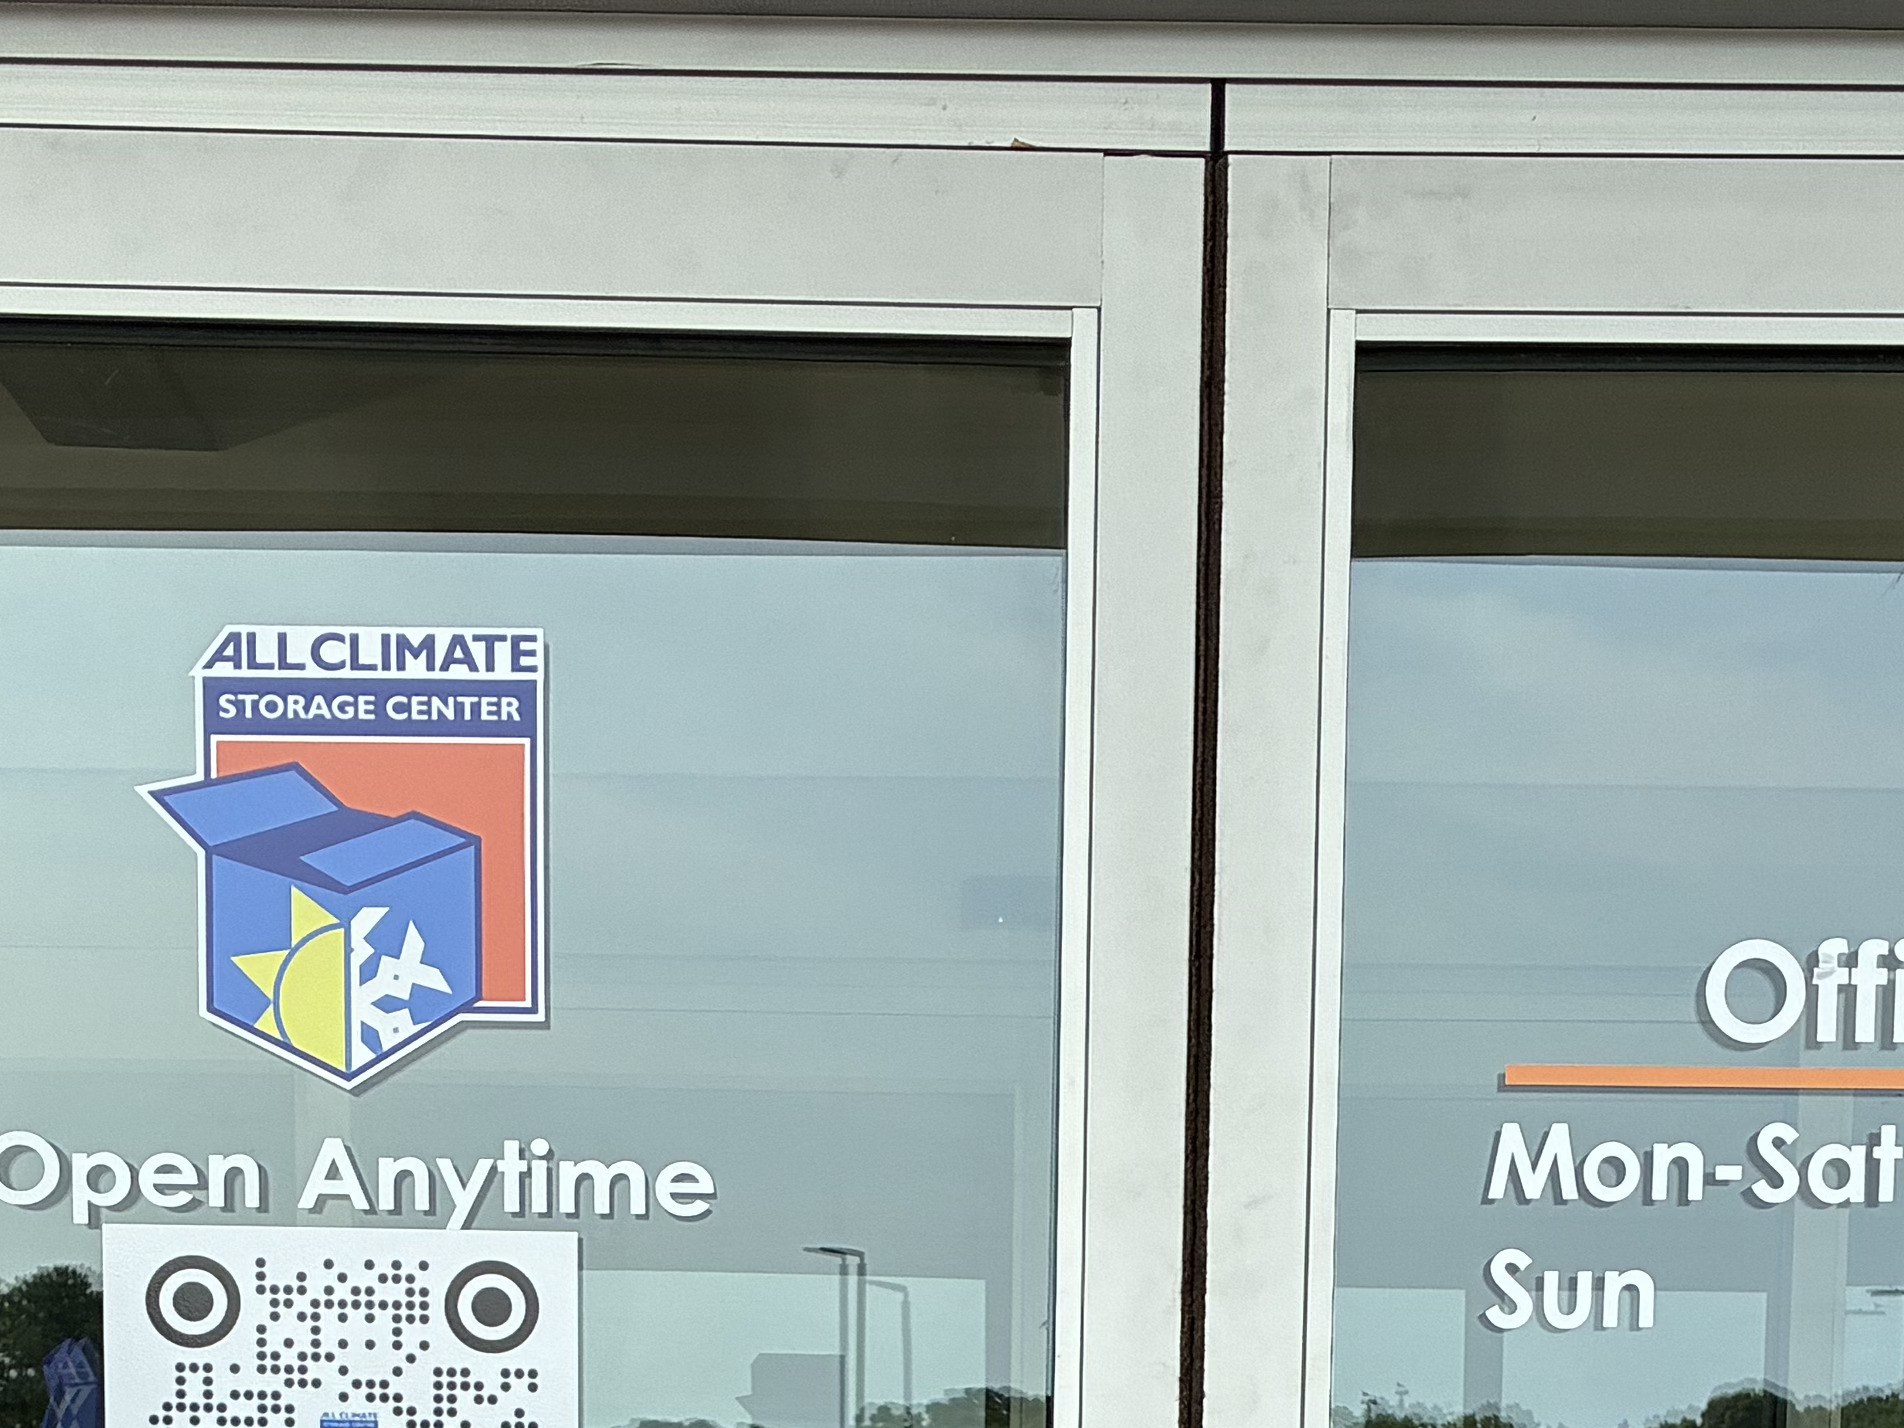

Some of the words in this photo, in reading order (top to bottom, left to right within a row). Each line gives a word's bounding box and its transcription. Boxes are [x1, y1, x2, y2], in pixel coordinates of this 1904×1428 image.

[204, 628, 311, 675] ALL
[308, 628, 540, 675] CLIMATE
[218, 693, 376, 720] STORAGE
[385, 695, 521, 722] CENTER
[299, 1137, 715, 1228] Anytime
[1487, 1122, 1904, 1204] Mon-Sat
[1485, 1248, 1655, 1330] Sun
